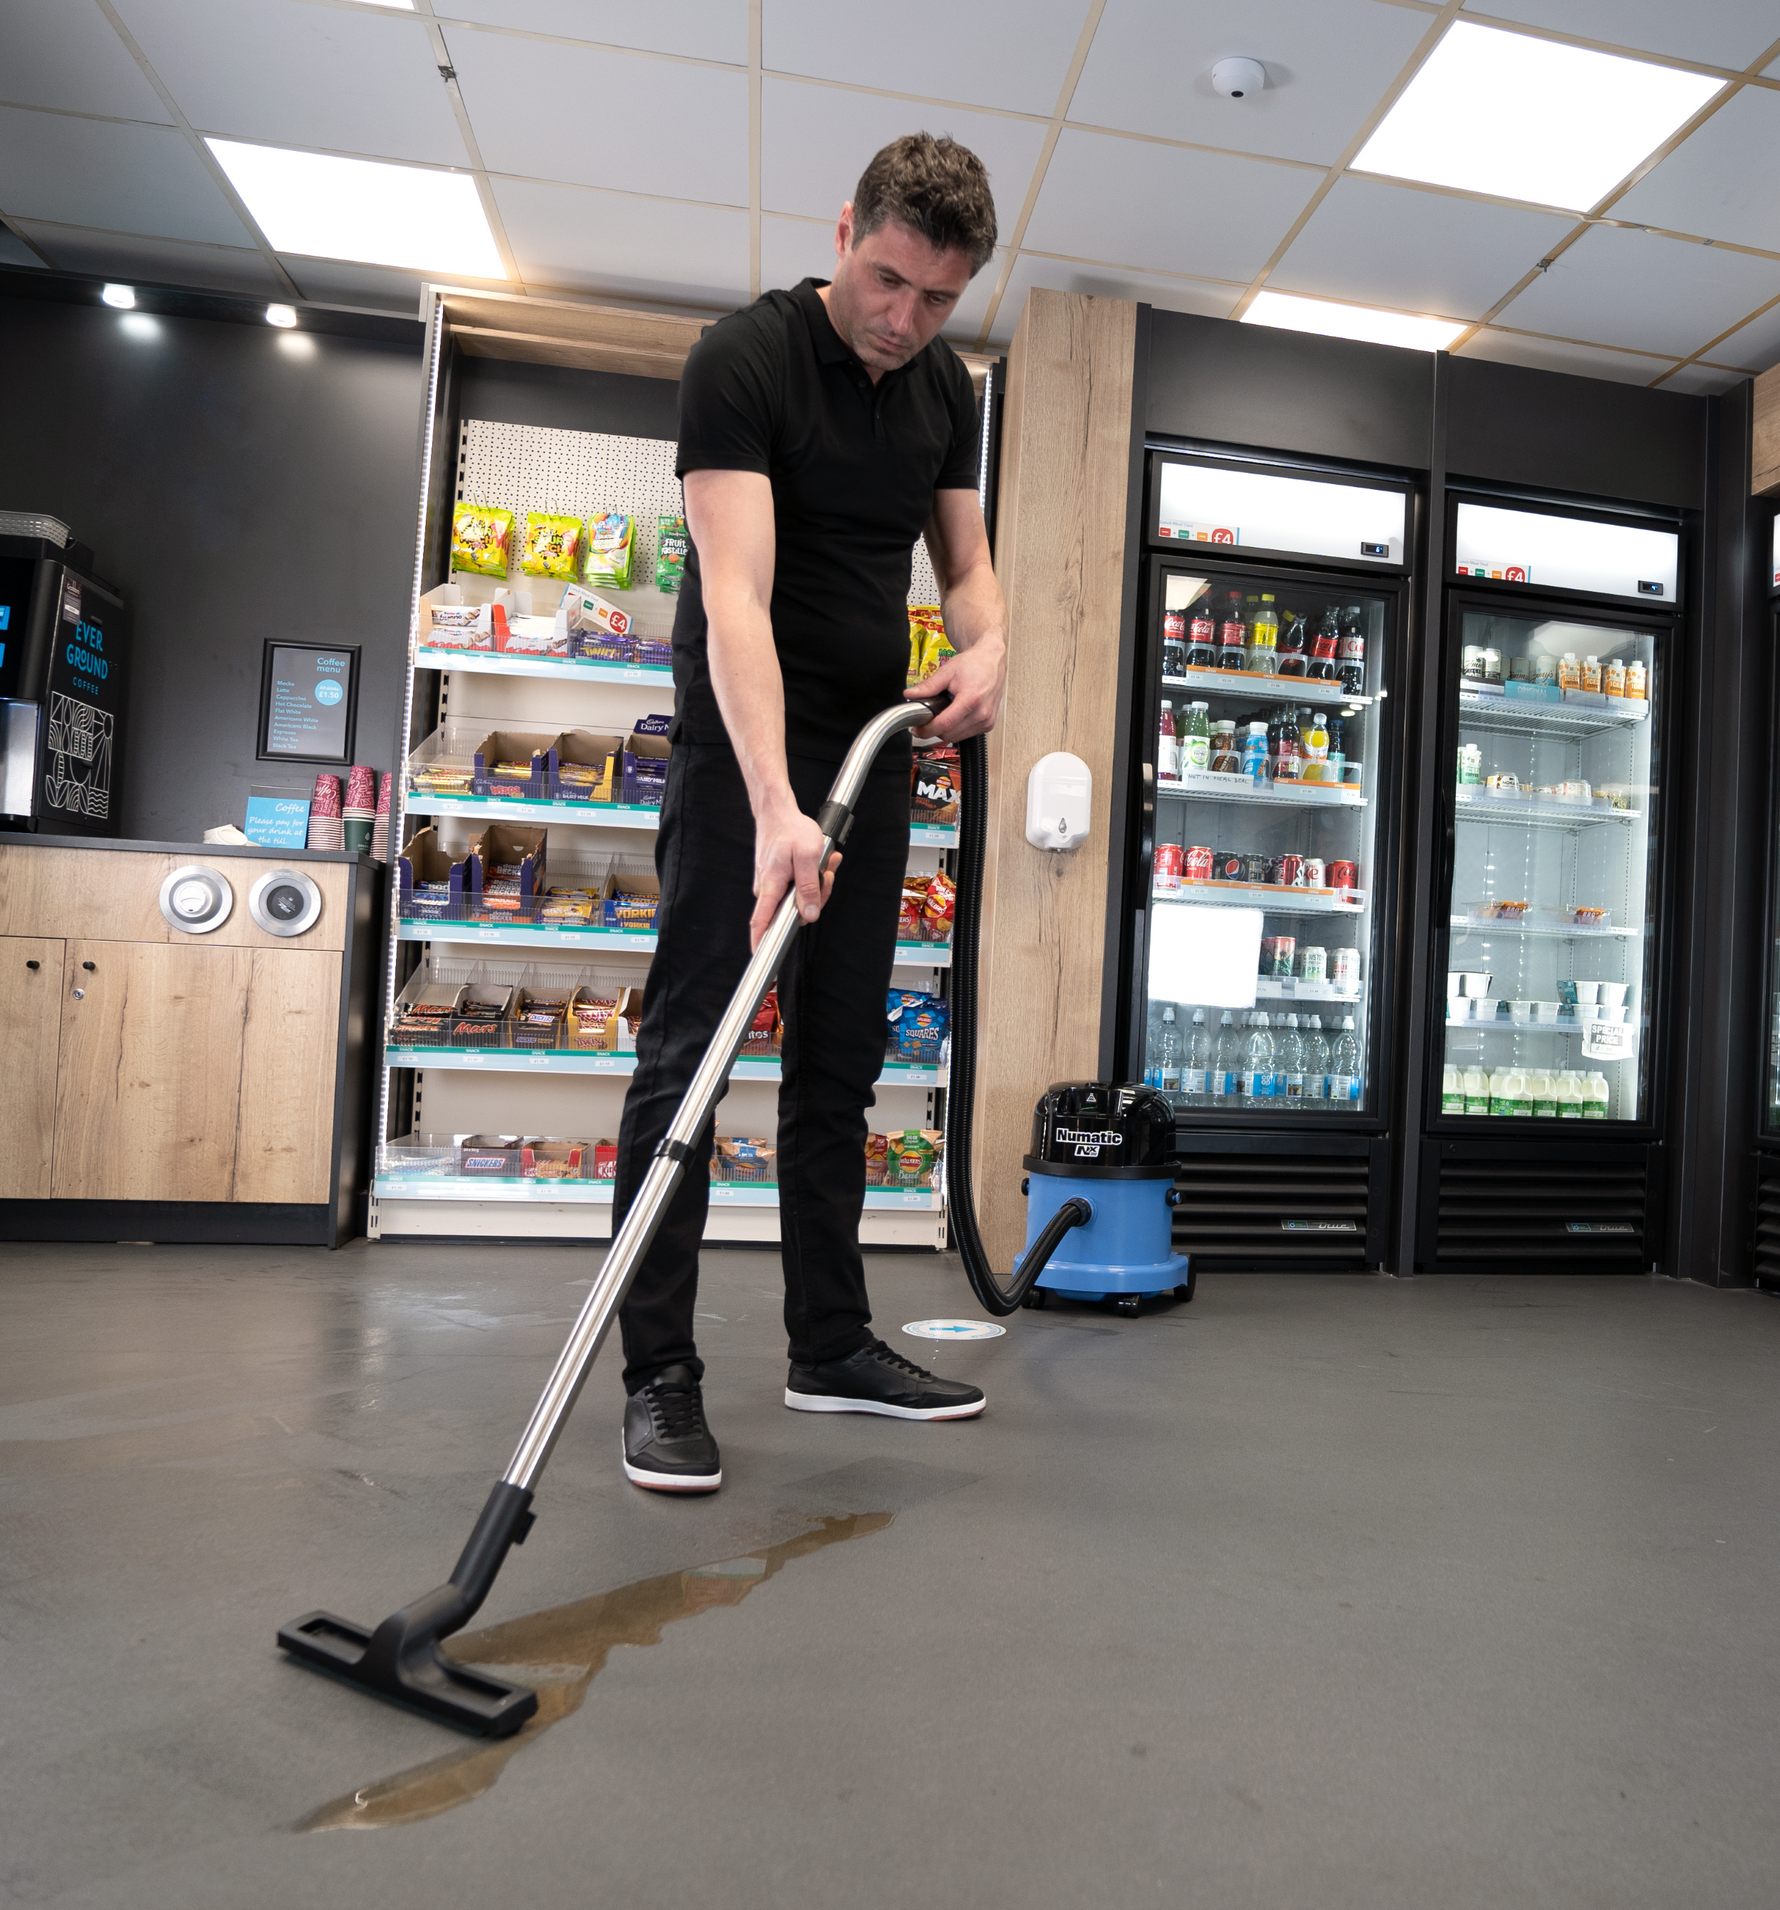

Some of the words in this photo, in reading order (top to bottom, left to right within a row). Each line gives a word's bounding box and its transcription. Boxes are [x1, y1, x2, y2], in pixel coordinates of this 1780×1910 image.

[1213, 532, 1232, 545] £4
[1507, 570, 1523, 583] £4
[611, 615, 626, 630] £4
[75, 620, 103, 652] EVER
[66, 644, 108, 680] GROUND
[317, 657, 345, 667] Coffee
[73, 677, 99, 695] COFFEE
[1517, 686, 1547, 694] ORIGINAL
[318, 691, 339, 699] £1.50
[640, 722, 664, 732] Dairy
[917, 781, 961, 804] MAX
[275, 803, 305, 814] Coffee
[249, 816, 274, 825] Please
[275, 818, 289, 827] pay
[292, 819, 305, 827] for
[247, 828, 266, 837] your
[268, 828, 292, 836] drink
[258, 836, 271, 844] the
[273, 837, 290, 845] till.
[411, 1004, 453, 1015] Mars
[453, 1022, 498, 1035] Mars
[906, 1027, 939, 1041] SQUARES
[1592, 1025, 1624, 1036] SPECIAL
[1595, 1035, 1619, 1045] PRICE
[1056, 1128, 1123, 1145] Numatic
[467, 1158, 504, 1168] SNICKERS
